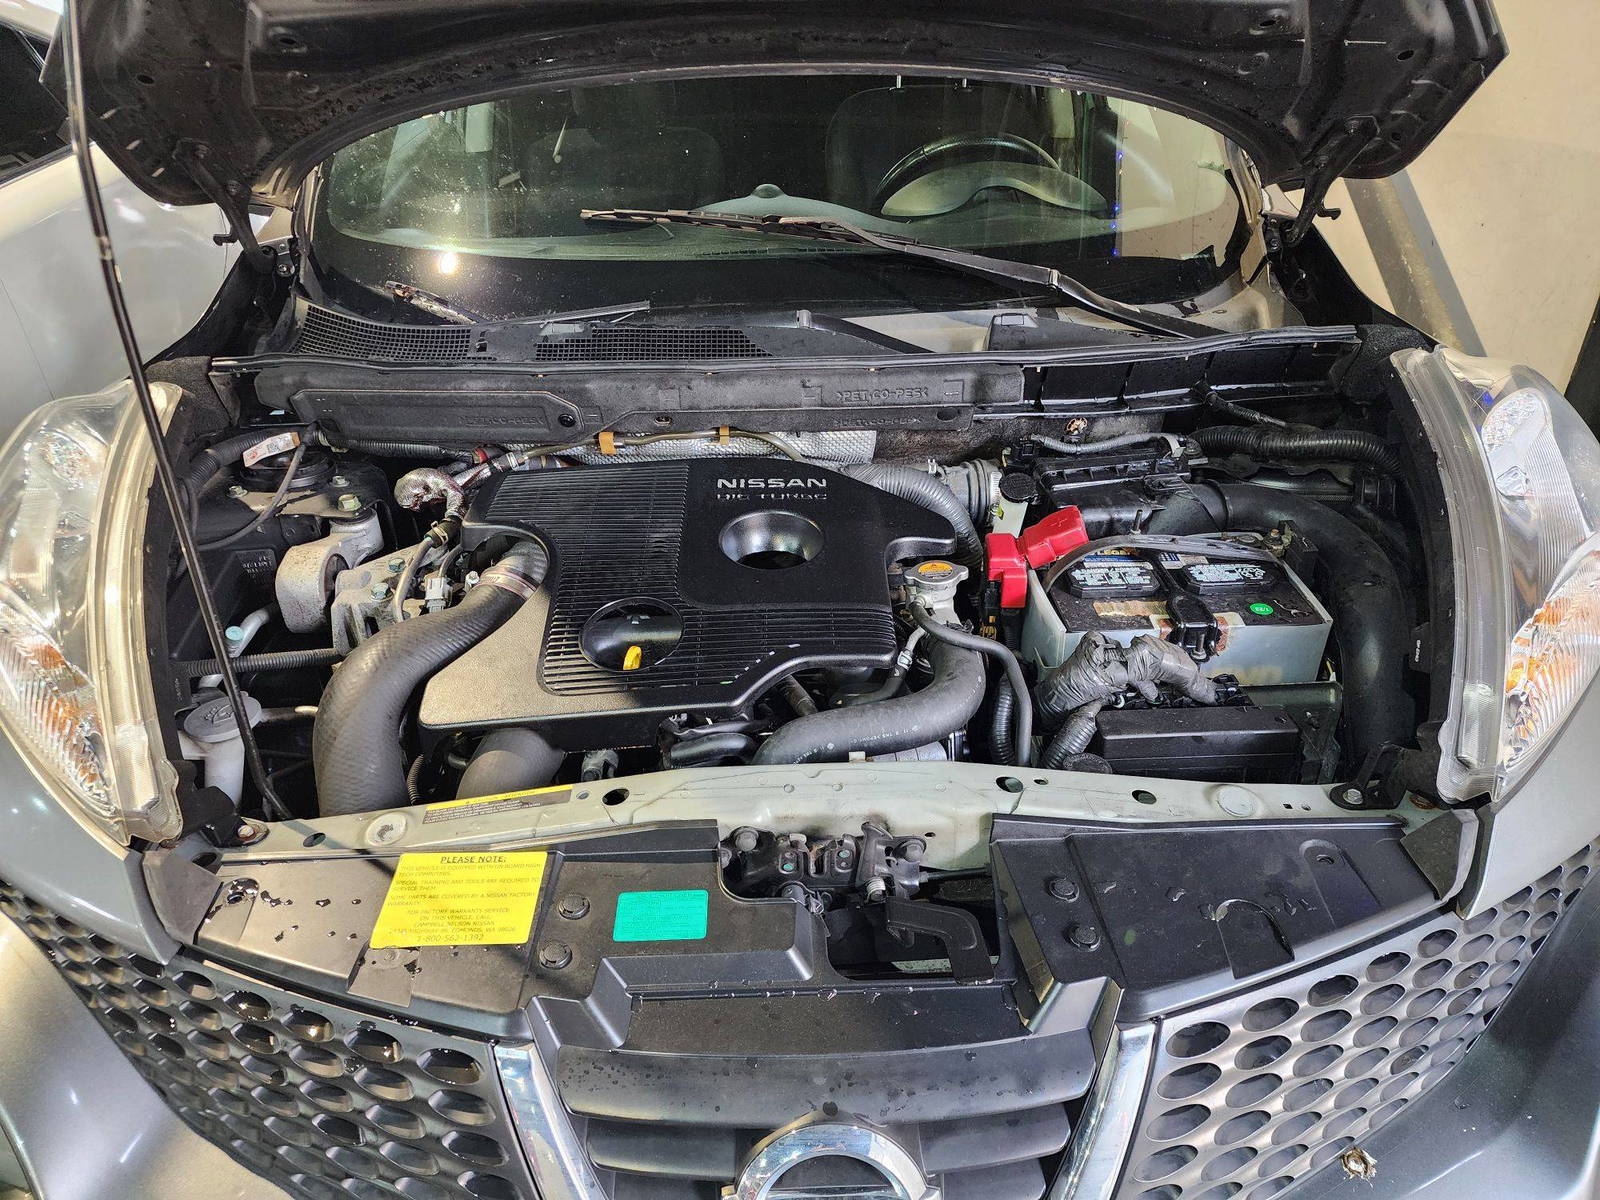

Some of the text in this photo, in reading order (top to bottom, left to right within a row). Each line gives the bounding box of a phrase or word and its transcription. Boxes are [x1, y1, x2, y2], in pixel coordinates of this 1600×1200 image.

[717, 478, 827, 489] NISSAN
[440, 855, 507, 864] PLEASE NOTE:
